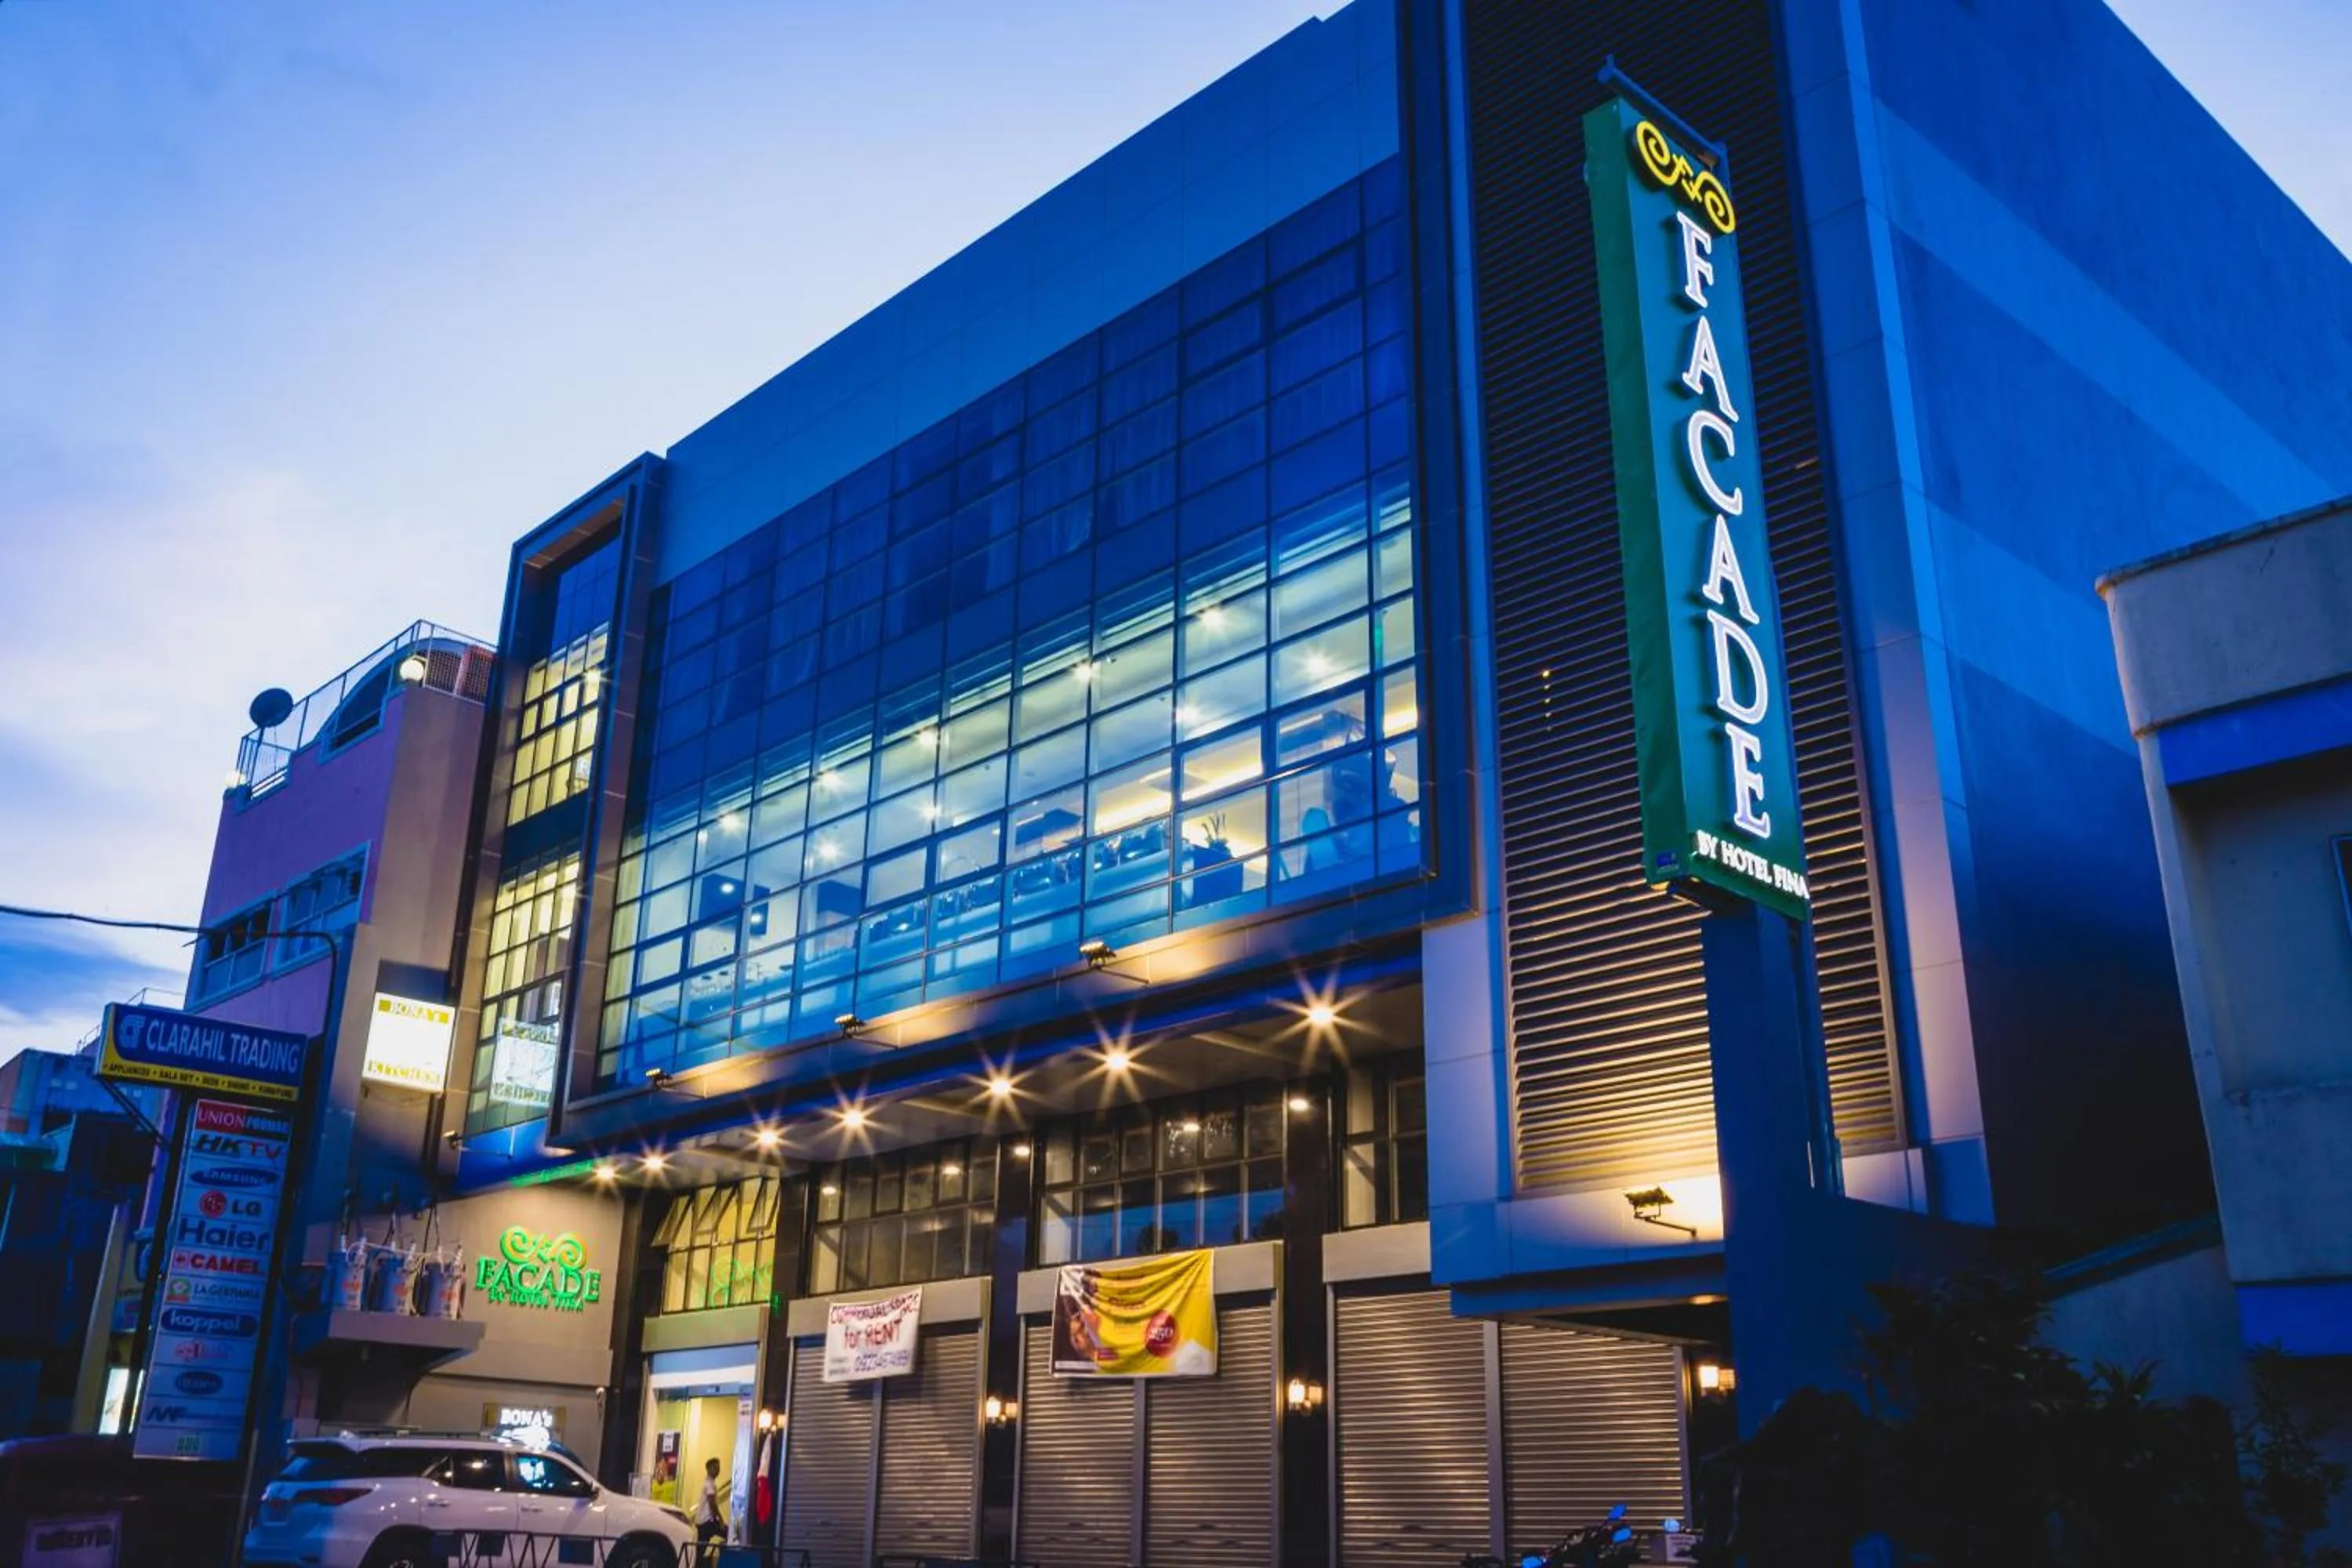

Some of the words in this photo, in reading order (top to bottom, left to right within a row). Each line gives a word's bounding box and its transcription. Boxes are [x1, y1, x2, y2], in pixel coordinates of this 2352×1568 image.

[1676, 209, 1770, 839] FACADE
[1696, 829, 1718, 859] BY
[1720, 840, 1773, 884] HOTEL
[146, 1020, 225, 1062] CLARAHIL
[230, 1032, 300, 1074] TRADING
[198, 1108, 245, 1127] UNION
[231, 1200, 261, 1215] LG
[177, 1218, 270, 1250] Haier
[190, 1253, 262, 1275] CAMEL
[475, 1255, 601, 1302] FACADE
[169, 1310, 241, 1332] koppel
[866, 1318, 902, 1347] RENT
